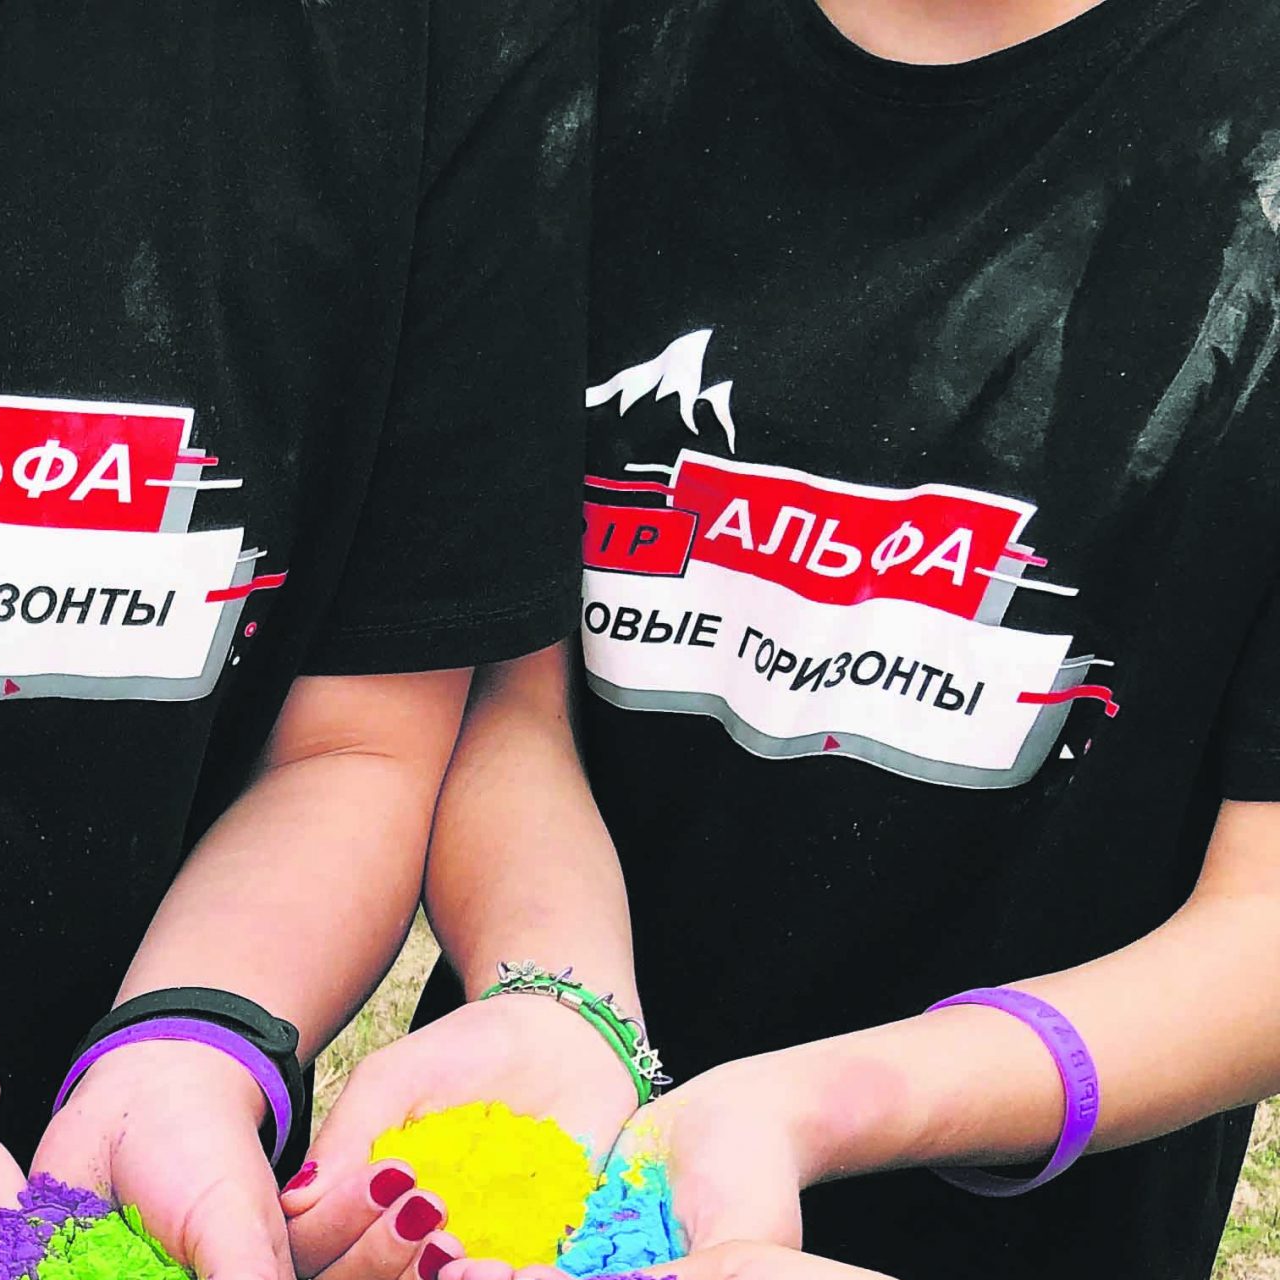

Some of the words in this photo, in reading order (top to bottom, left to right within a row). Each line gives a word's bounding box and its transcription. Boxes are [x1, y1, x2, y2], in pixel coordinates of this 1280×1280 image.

[583, 516, 660, 556] IP
[704, 497, 974, 587] АЛЬФА
[583, 601, 723, 648] ОВЫЕ
[737, 625, 986, 716] ГОРИЗОНТЫ
